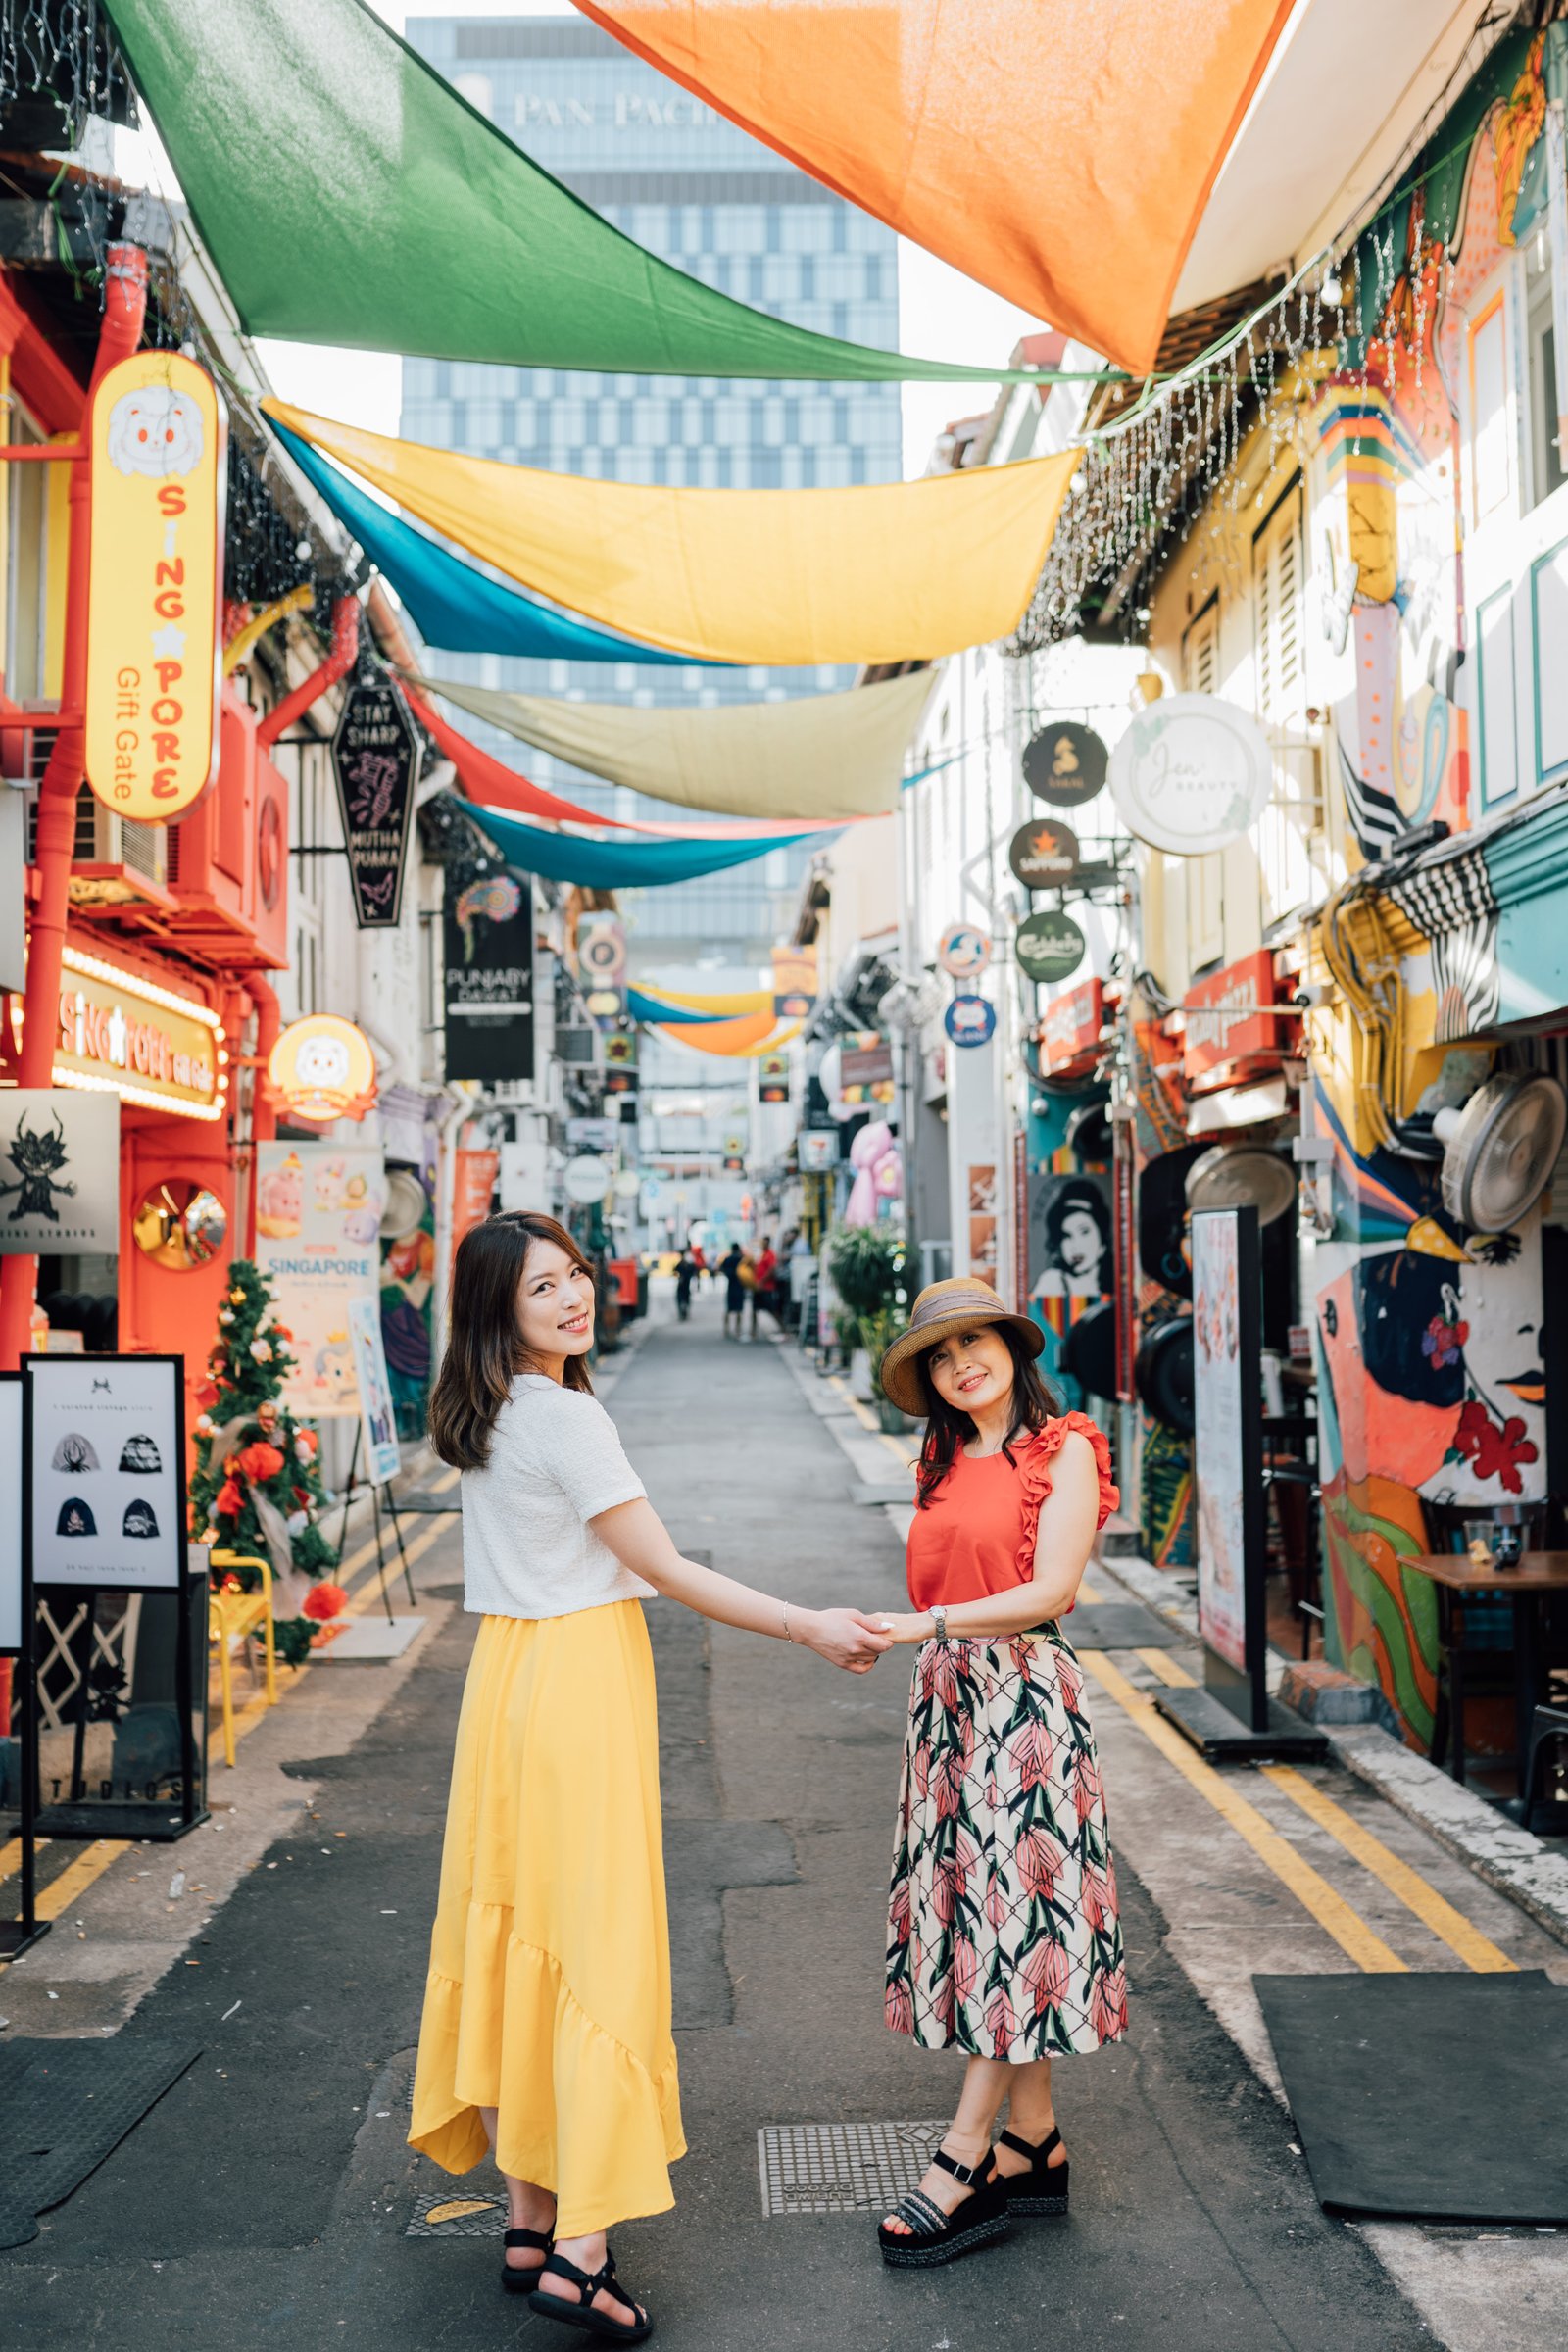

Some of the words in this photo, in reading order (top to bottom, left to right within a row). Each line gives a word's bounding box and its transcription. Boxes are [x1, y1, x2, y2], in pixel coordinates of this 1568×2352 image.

[514, 94, 595, 125] PAN
[116, 667, 141, 720] Gift
[352, 704, 391, 723] STAY
[347, 725, 400, 746] SHARP
[114, 730, 139, 800] Gate
[1176, 781, 1237, 791] BEAUTY
[269, 1258, 369, 1276] SINGAPORE
[51, 1779, 183, 1800] TUDIOS
